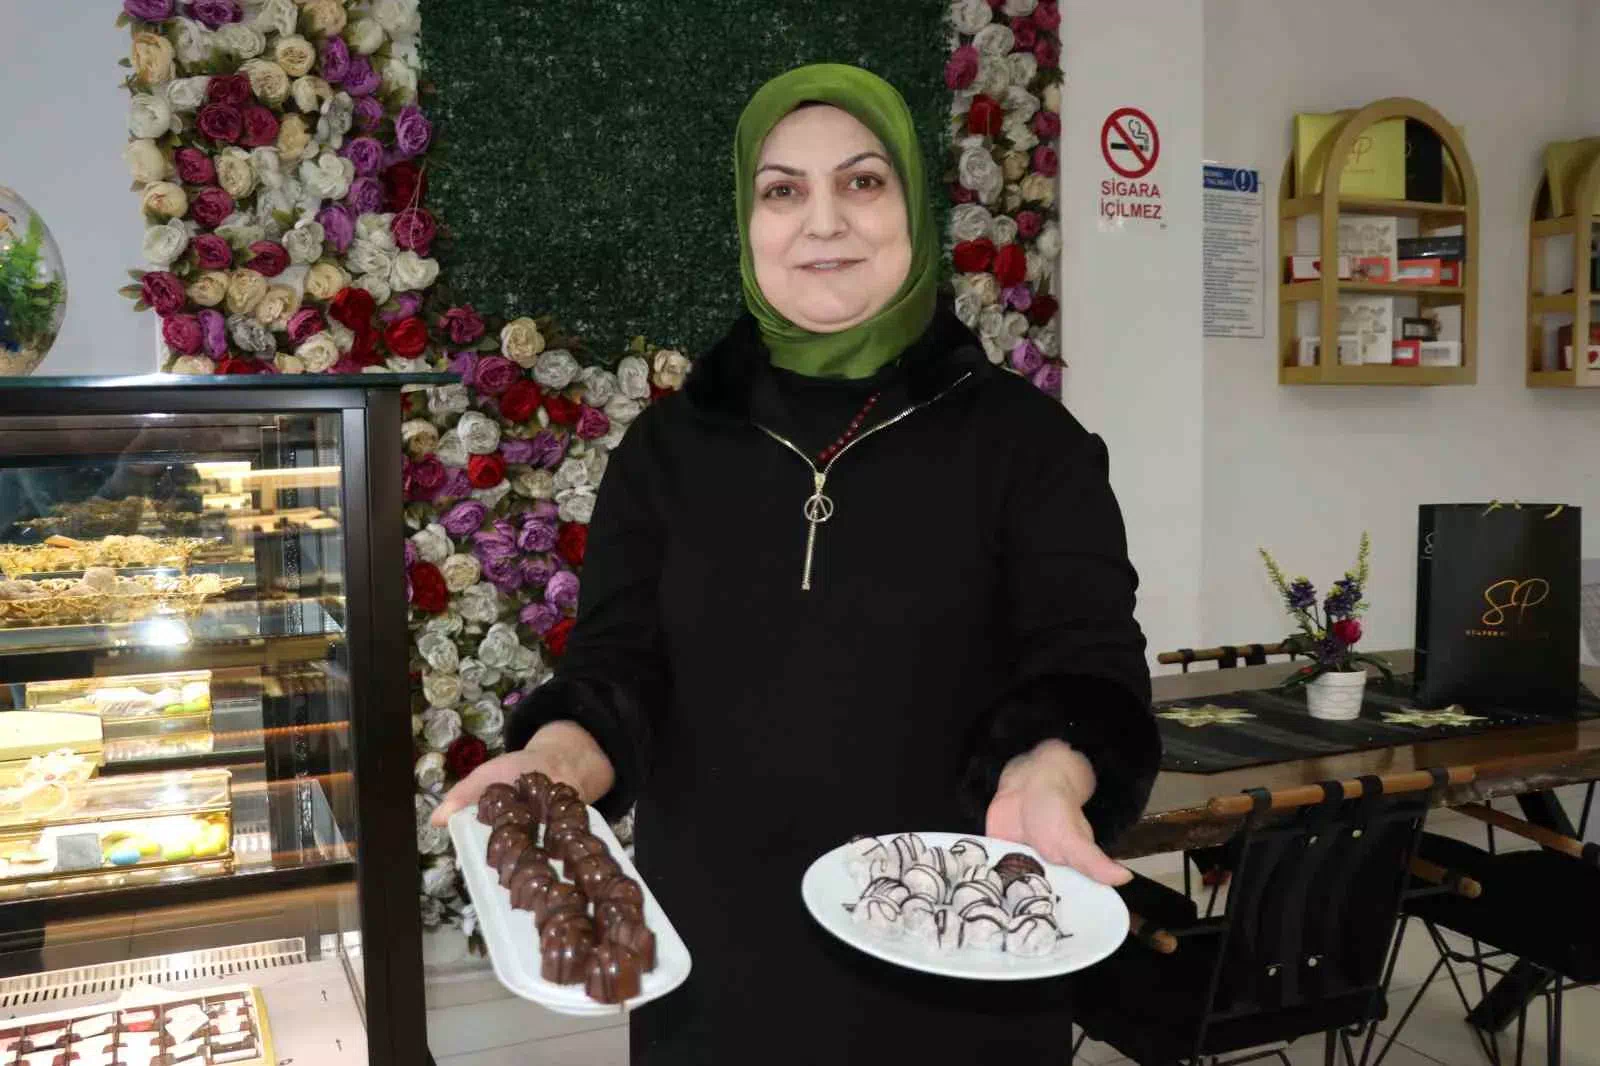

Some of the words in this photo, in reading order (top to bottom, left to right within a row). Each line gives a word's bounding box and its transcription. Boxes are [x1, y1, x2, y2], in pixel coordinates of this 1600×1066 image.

[1101, 178, 1161, 198] SİGARA
[1100, 198, 1163, 220] İÇİLMEZ
[1481, 577, 1550, 625] SP
